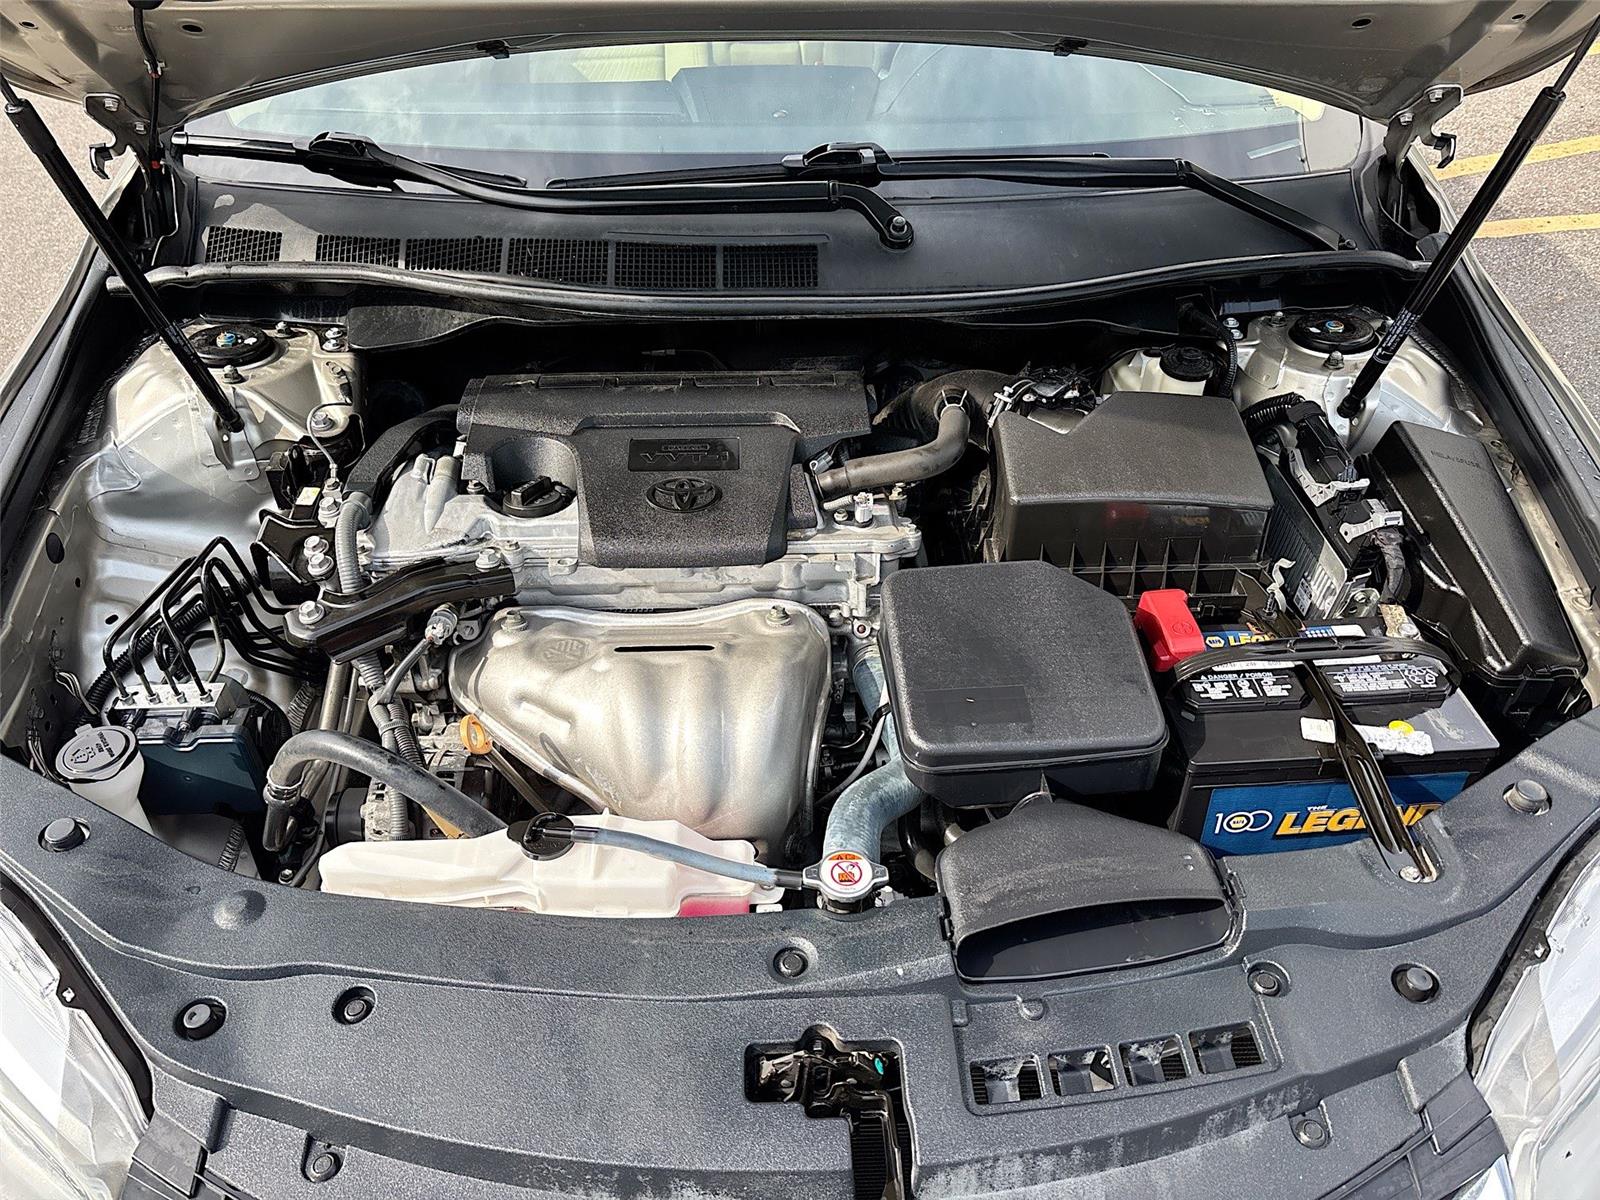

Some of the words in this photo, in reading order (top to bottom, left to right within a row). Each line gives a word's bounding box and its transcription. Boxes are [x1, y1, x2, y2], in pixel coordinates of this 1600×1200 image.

[1207, 673, 1239, 681] DANGER
[1244, 671, 1274, 679] POISON
[1214, 809, 1273, 834] 100
[1275, 803, 1441, 836] LEGND
